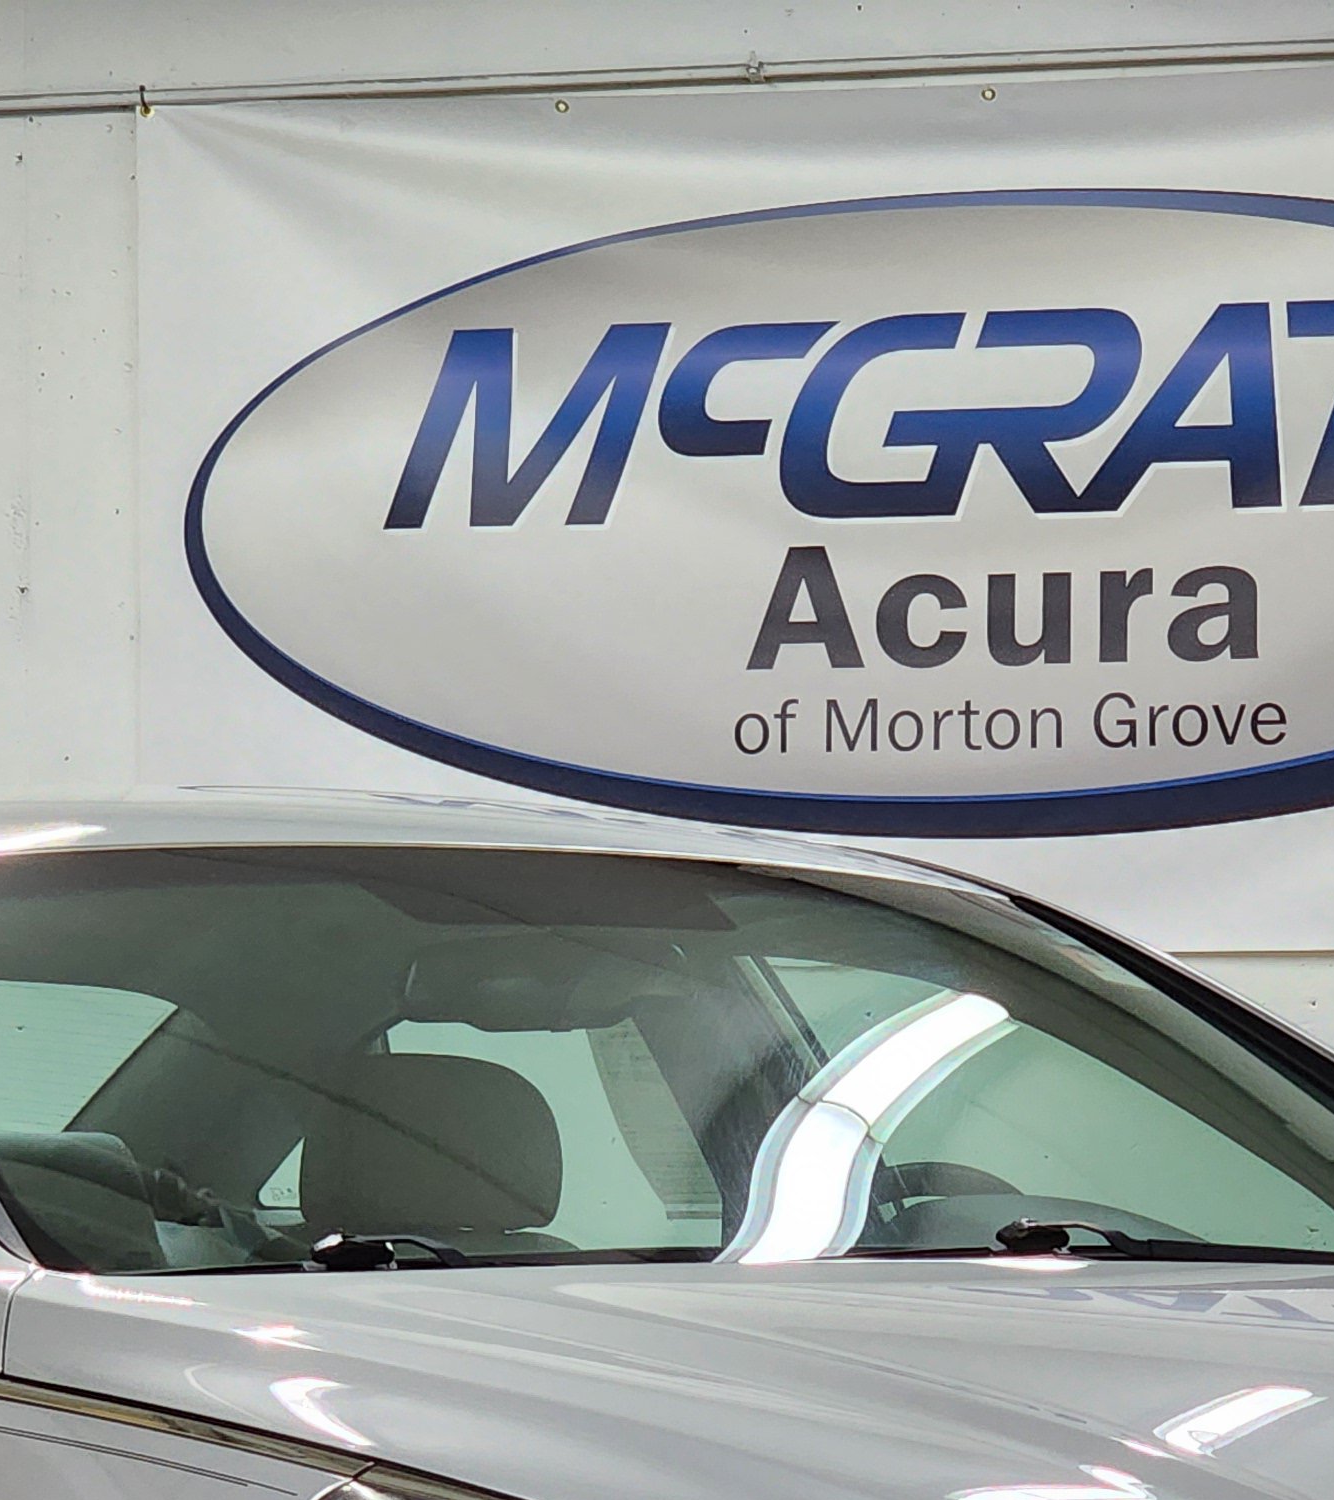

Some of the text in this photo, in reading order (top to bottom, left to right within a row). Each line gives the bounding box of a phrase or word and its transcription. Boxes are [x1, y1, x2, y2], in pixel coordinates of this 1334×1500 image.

[746, 545, 1259, 670] Acura
[734, 690, 1288, 755] of Morton Grove
